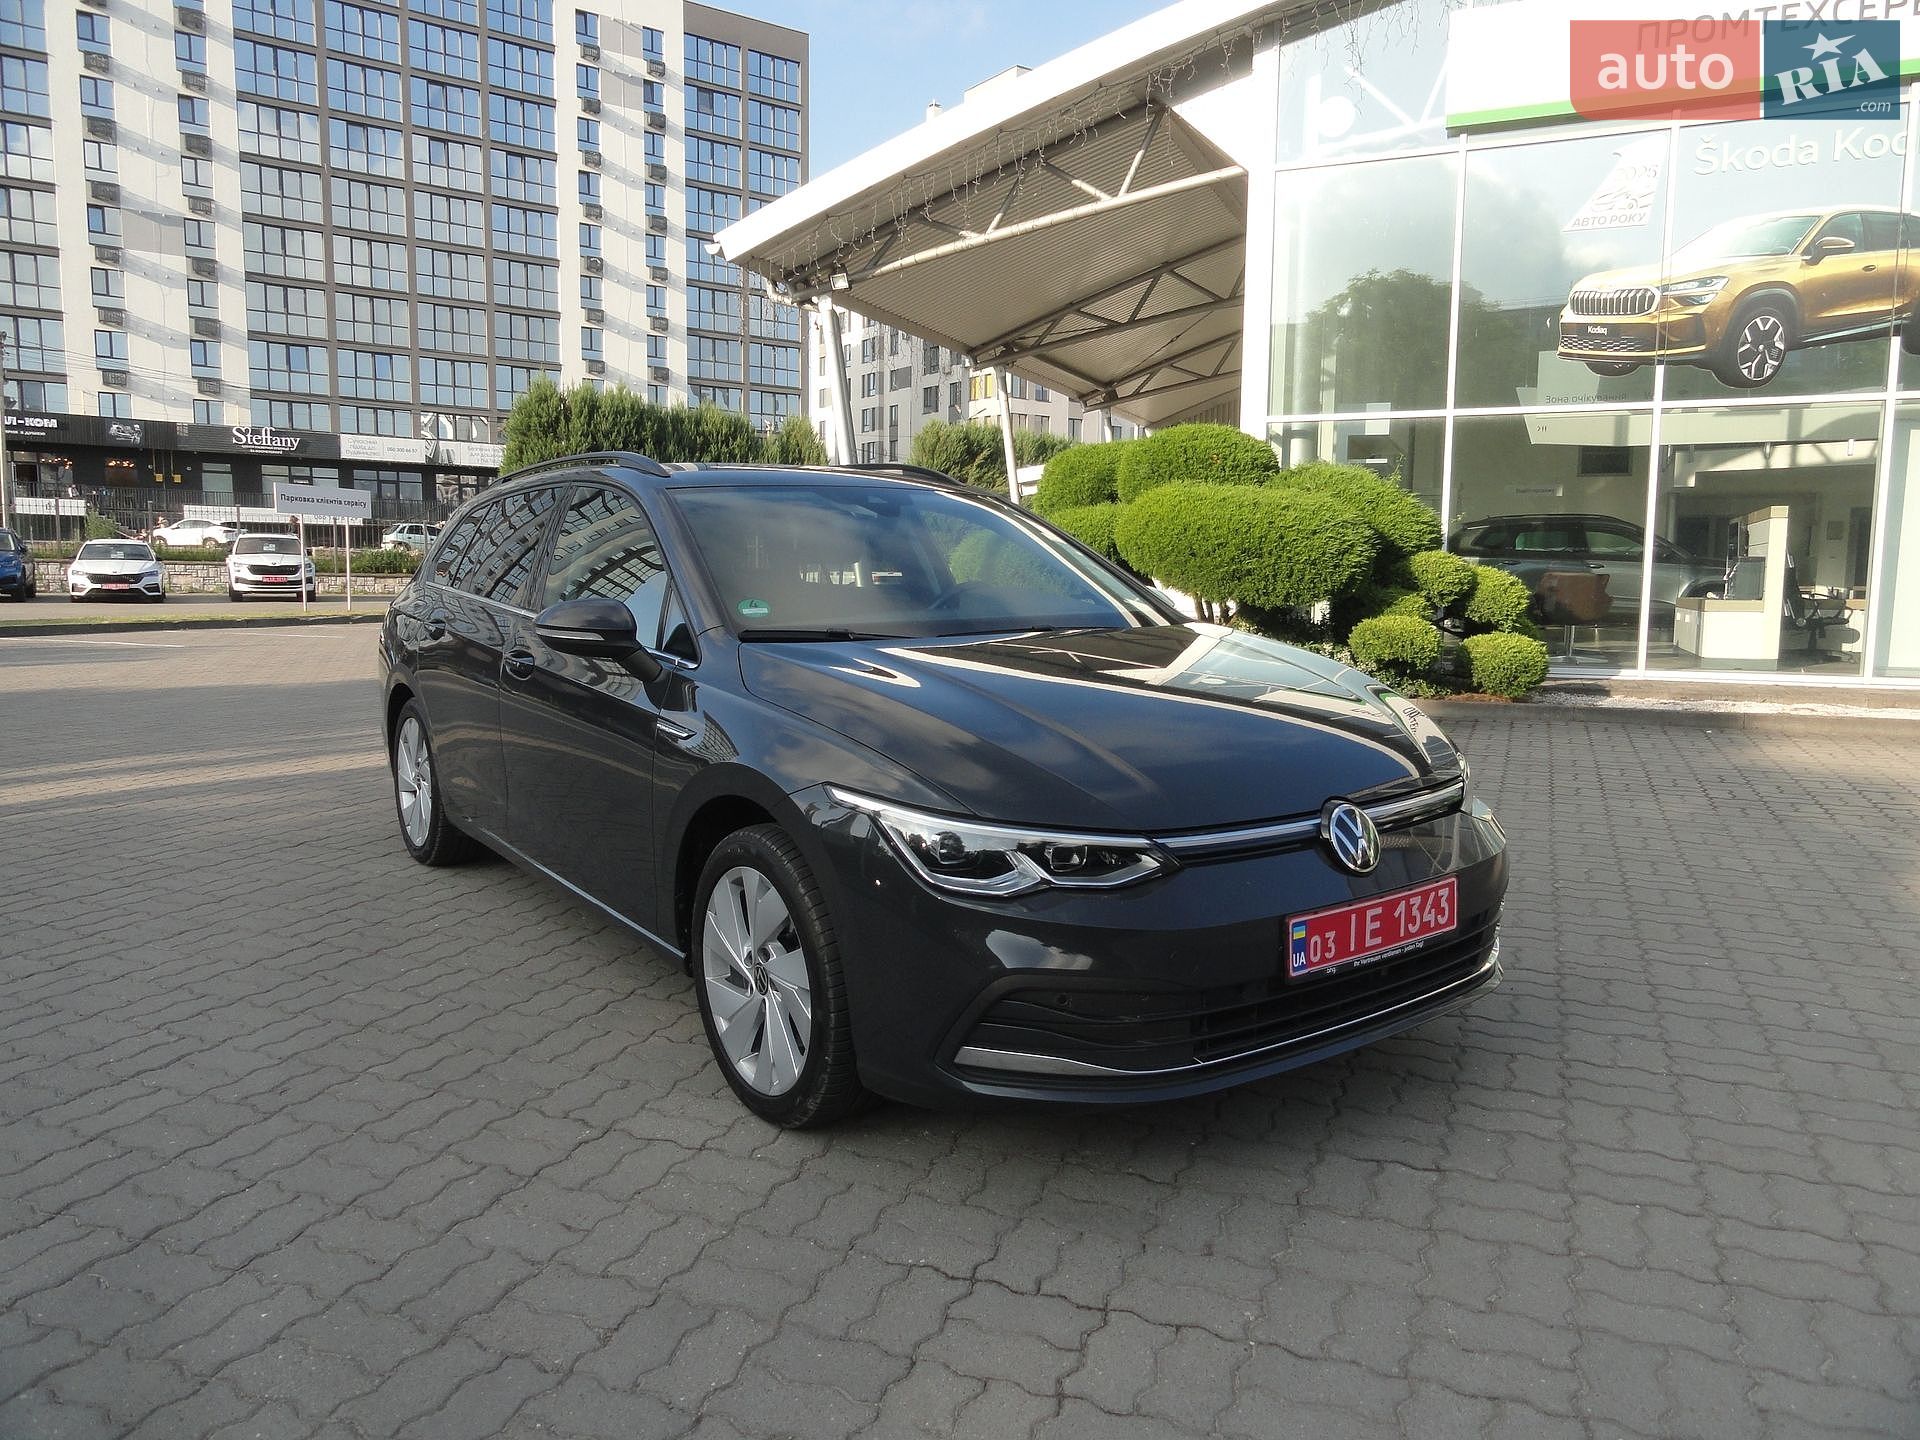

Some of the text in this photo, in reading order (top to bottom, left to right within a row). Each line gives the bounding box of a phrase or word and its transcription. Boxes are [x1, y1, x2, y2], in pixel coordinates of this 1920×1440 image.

[1637, 0, 1920, 51] ПРОМТЕХСЕР
[1695, 133, 1818, 176] Škoda
[1571, 212, 1647, 228] АВТО РОКУ
[1545, 395, 1569, 404] Зона
[232, 426, 301, 451] Steffany
[280, 493, 368, 508] Парковка клієнтів сервісу
[1309, 887, 1449, 963] 03 IE 1343
[1293, 952, 1306, 968] UA
